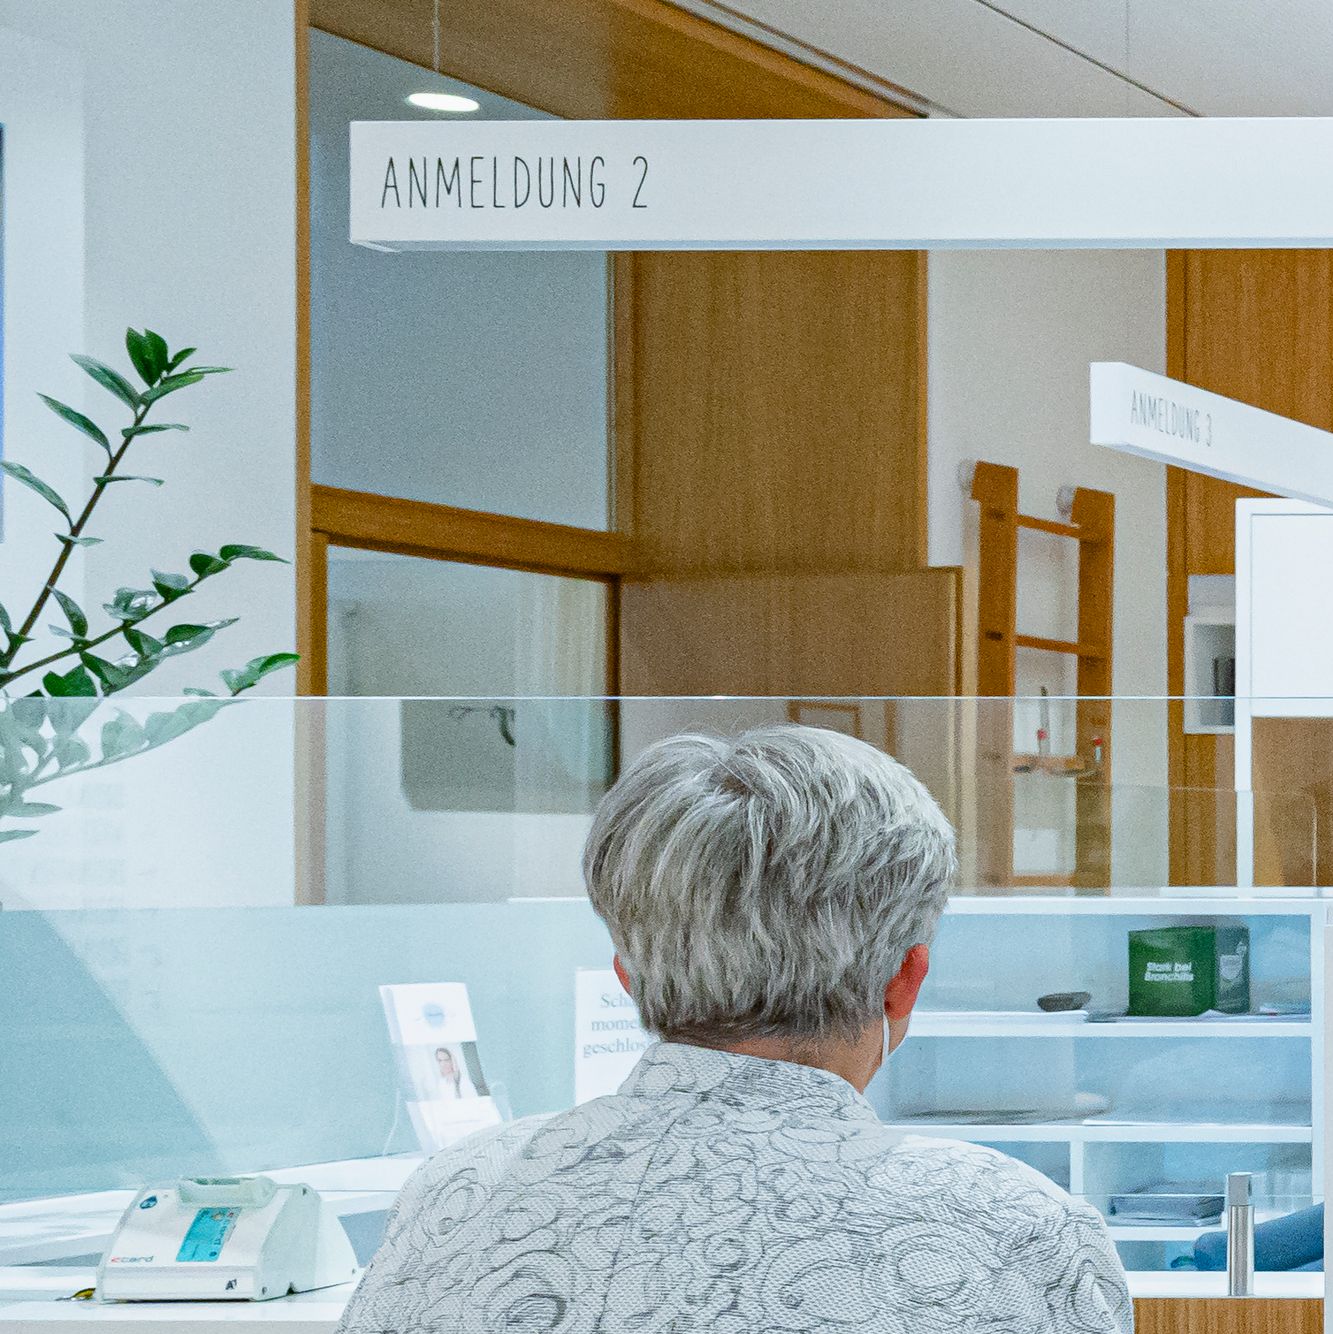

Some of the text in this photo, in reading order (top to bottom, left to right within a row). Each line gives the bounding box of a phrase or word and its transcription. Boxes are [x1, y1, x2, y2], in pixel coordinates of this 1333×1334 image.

[381, 155, 649, 209] ANMELDUNG 2
[1130, 389, 1213, 447] ANMELDUNG 3
[591, 1020, 639, 1032] mome
[583, 1038, 648, 1059] geschlos
